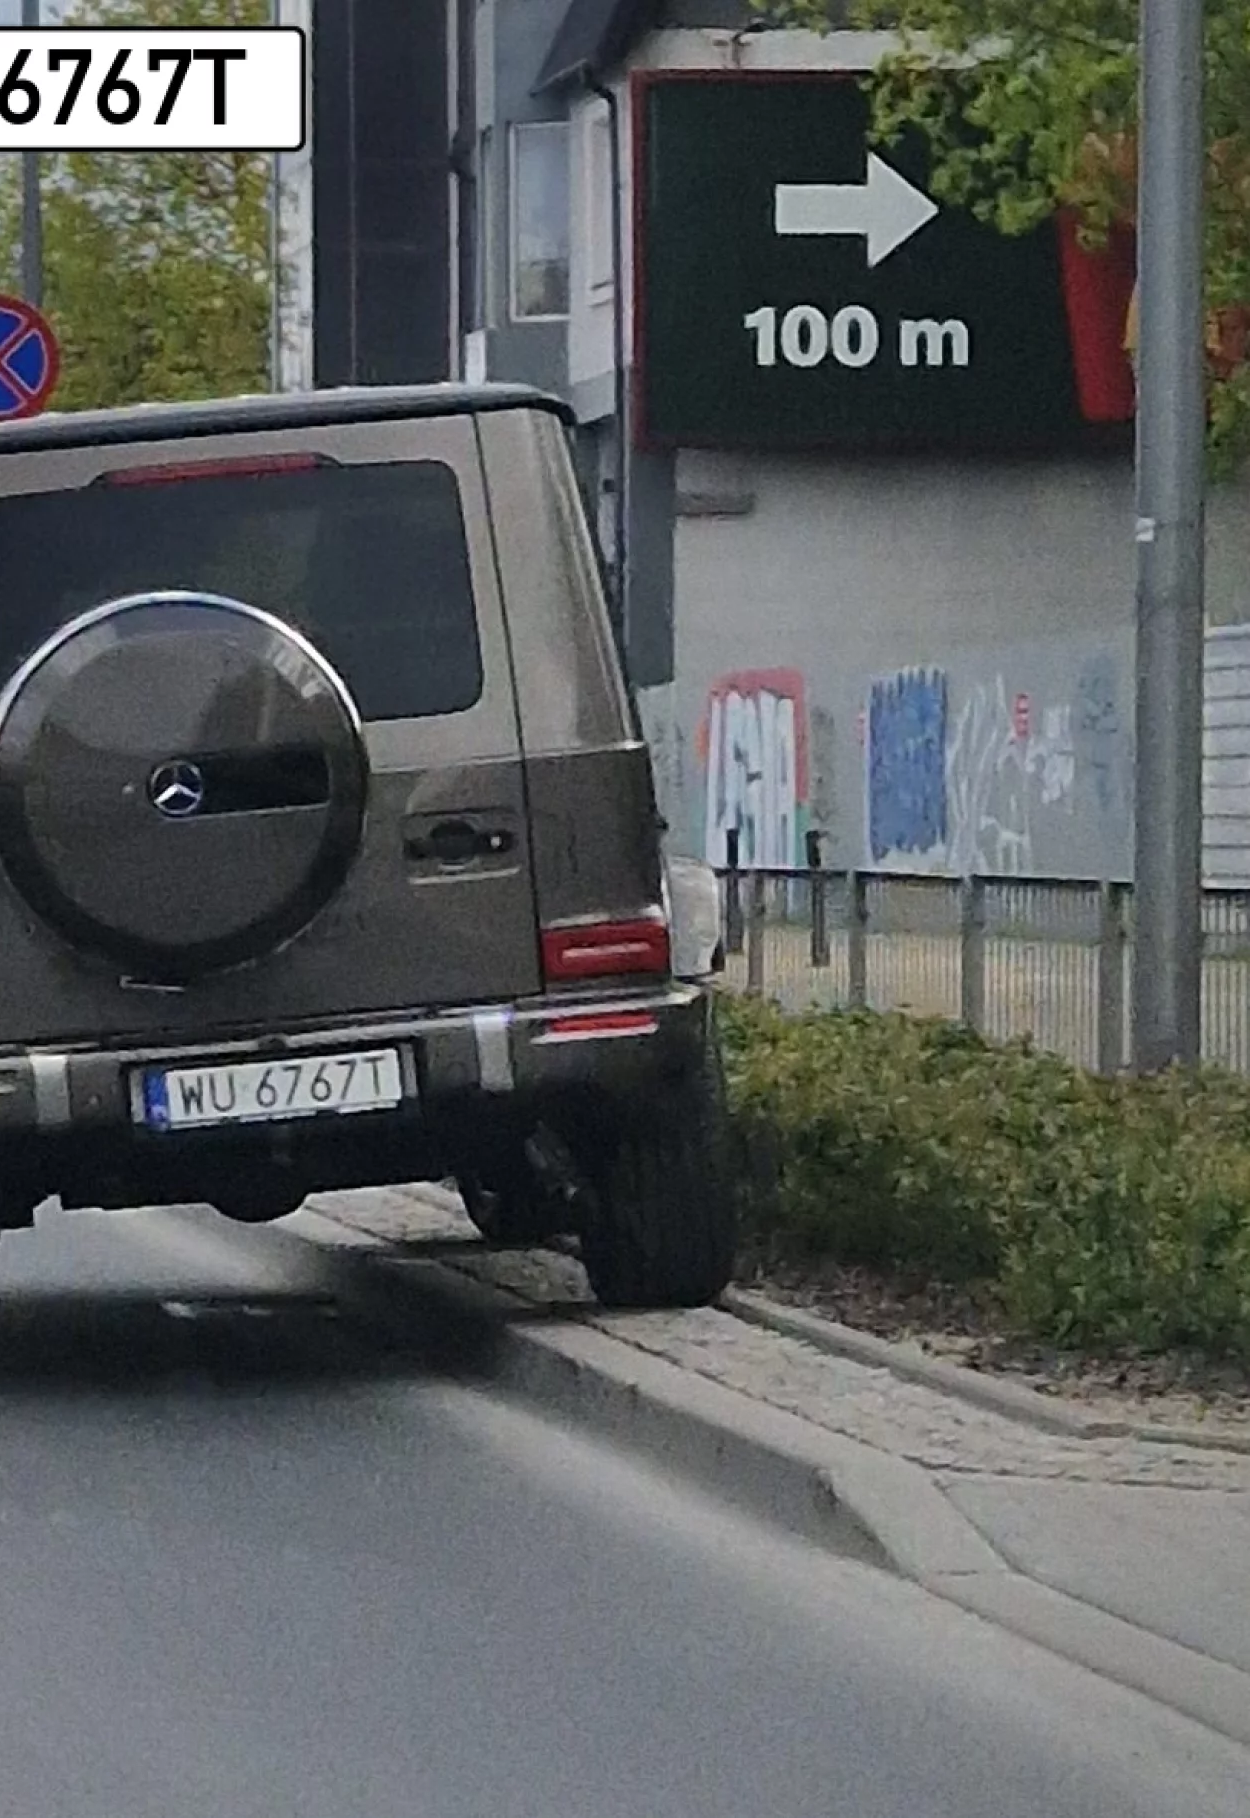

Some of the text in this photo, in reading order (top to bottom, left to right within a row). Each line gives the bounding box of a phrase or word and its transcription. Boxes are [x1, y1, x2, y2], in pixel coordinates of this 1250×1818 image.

[743, 304, 969, 368] 100 m
[178, 1071, 236, 1116] WU
[256, 1055, 386, 1108] 6767T
